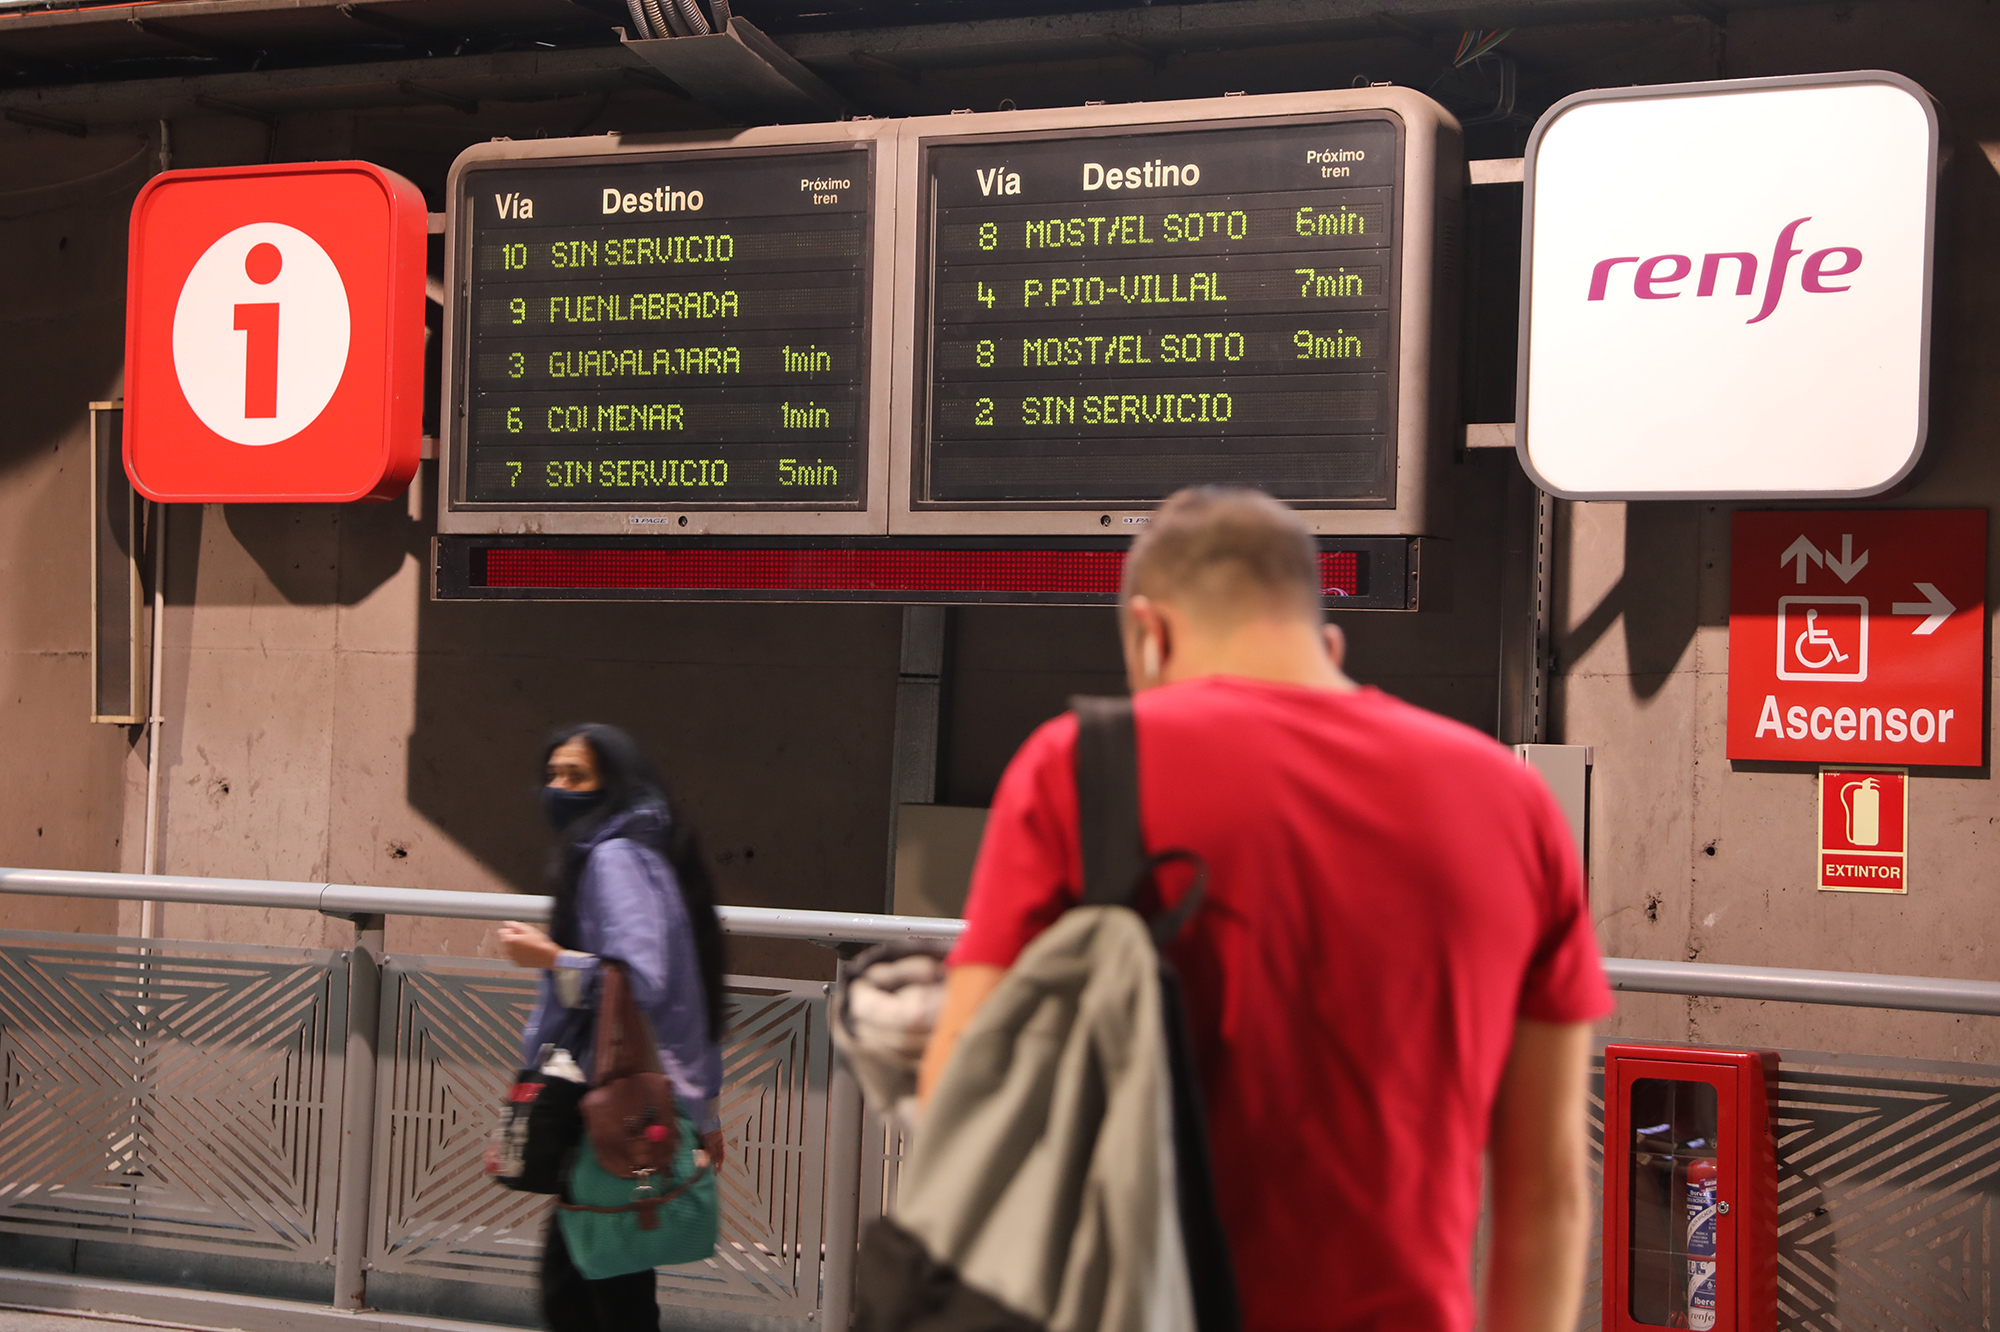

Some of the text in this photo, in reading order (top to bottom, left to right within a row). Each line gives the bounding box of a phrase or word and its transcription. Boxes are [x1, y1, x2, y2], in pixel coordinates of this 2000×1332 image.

[1306, 148, 1366, 164] Próximo
[1320, 165, 1350, 179] tren
[800, 177, 851, 192] Próximo
[976, 158, 1201, 197] Vía Destino
[494, 185, 704, 220] Vía Destino
[812, 192, 838, 205] tren
[978, 205, 1365, 251] 8 MOST/EL SOTO 6min
[502, 234, 734, 270] 10 SIN SERVICIO
[977, 267, 1363, 309] 4 P.PIO-VILLAL 7min
[1587, 216, 1863, 325] renfe
[509, 290, 739, 325] 9 FUENLABRADA
[508, 344, 831, 379] 3 GUADALAJARA 1min
[976, 328, 1362, 368] 8 MOST/EL SOTO 9min
[507, 406, 523, 433] 6
[781, 401, 830, 429] 1min
[974, 393, 1233, 426] 2 SIN SERVICIO
[506, 458, 838, 488] 7 SIN SERVICIO 5min
[1754, 694, 1955, 744] Ascensor
[1825, 863, 1901, 879] EXTINTOR
[1690, 1311, 1715, 1324] renfe
